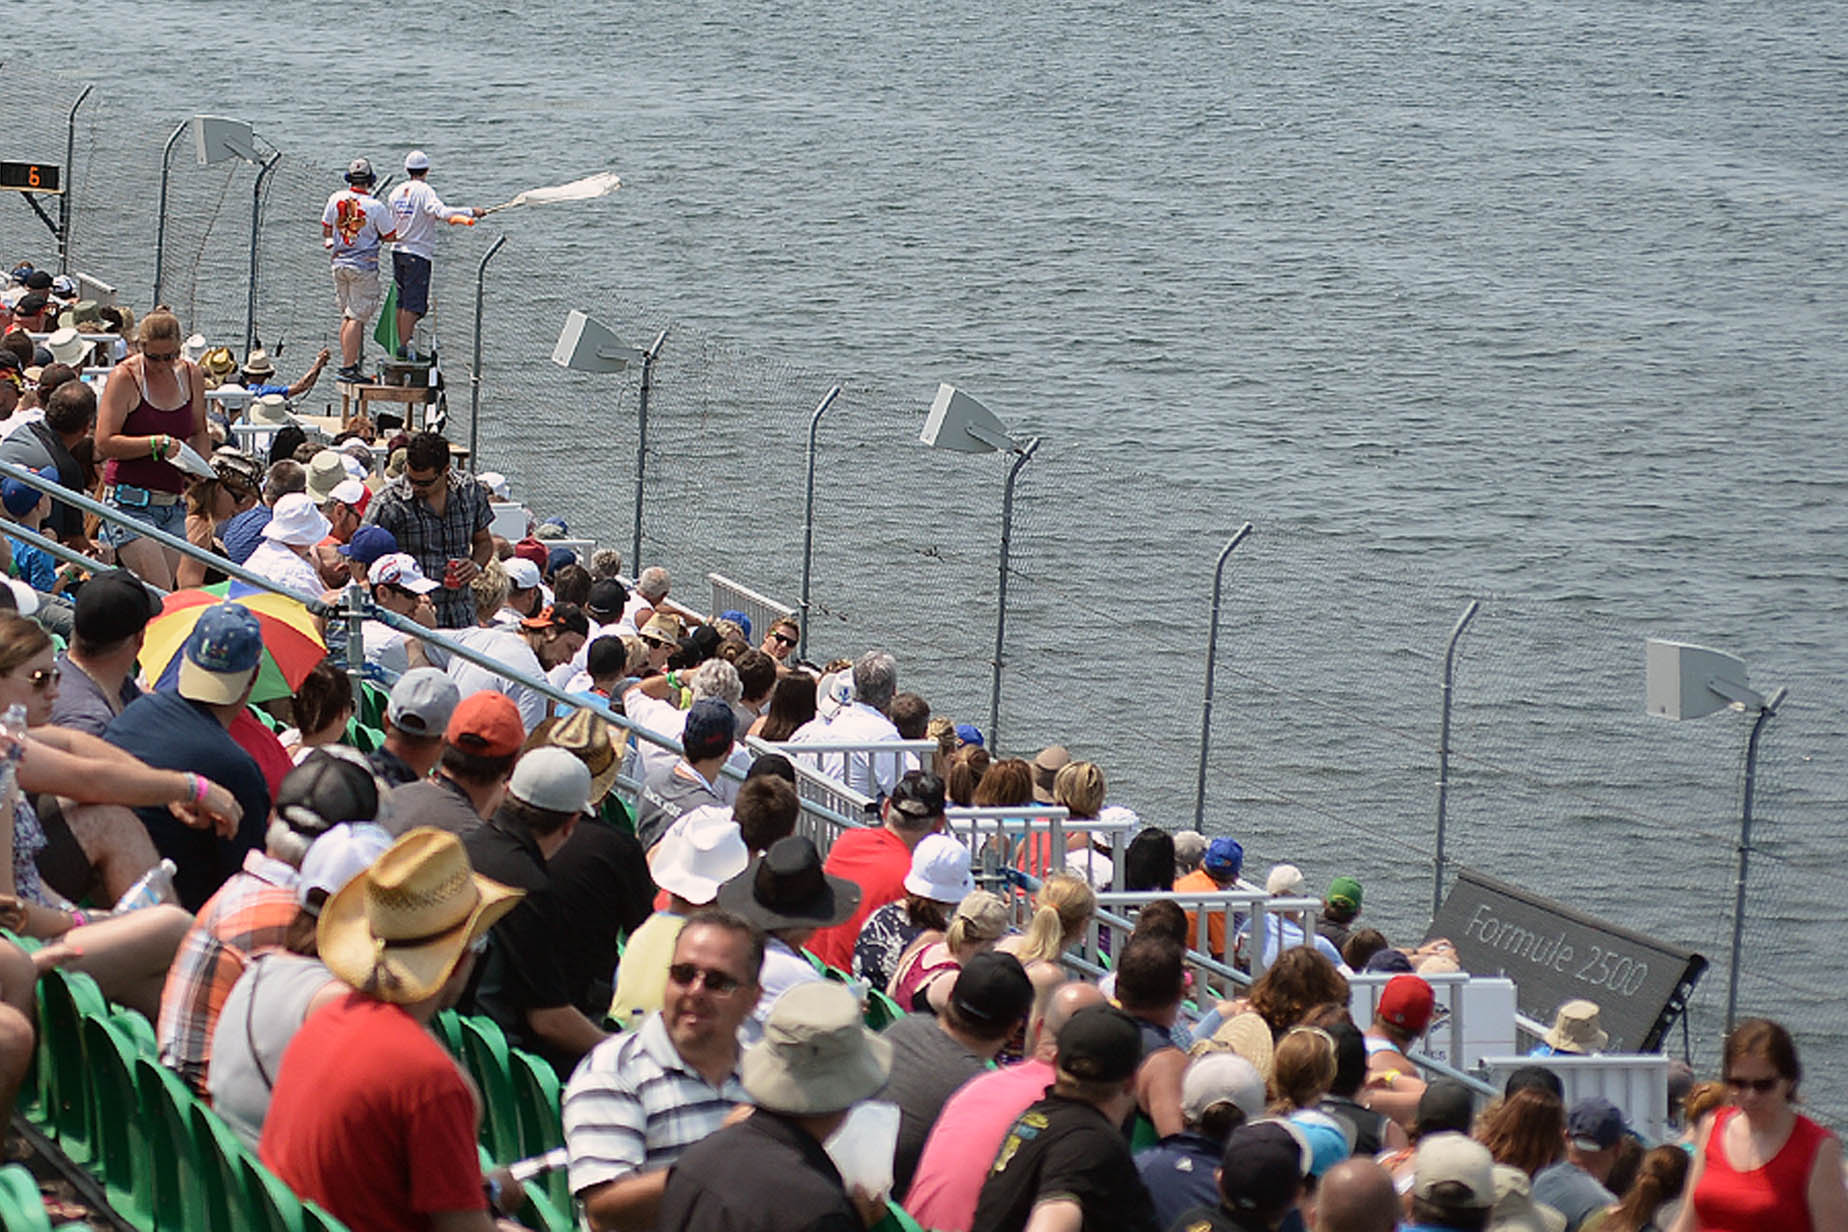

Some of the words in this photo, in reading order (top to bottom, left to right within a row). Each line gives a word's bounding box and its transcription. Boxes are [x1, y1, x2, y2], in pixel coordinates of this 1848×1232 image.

[29, 166, 40, 186] 6
[1464, 904, 1575, 972] Formule
[1575, 945, 1649, 998] 2500
